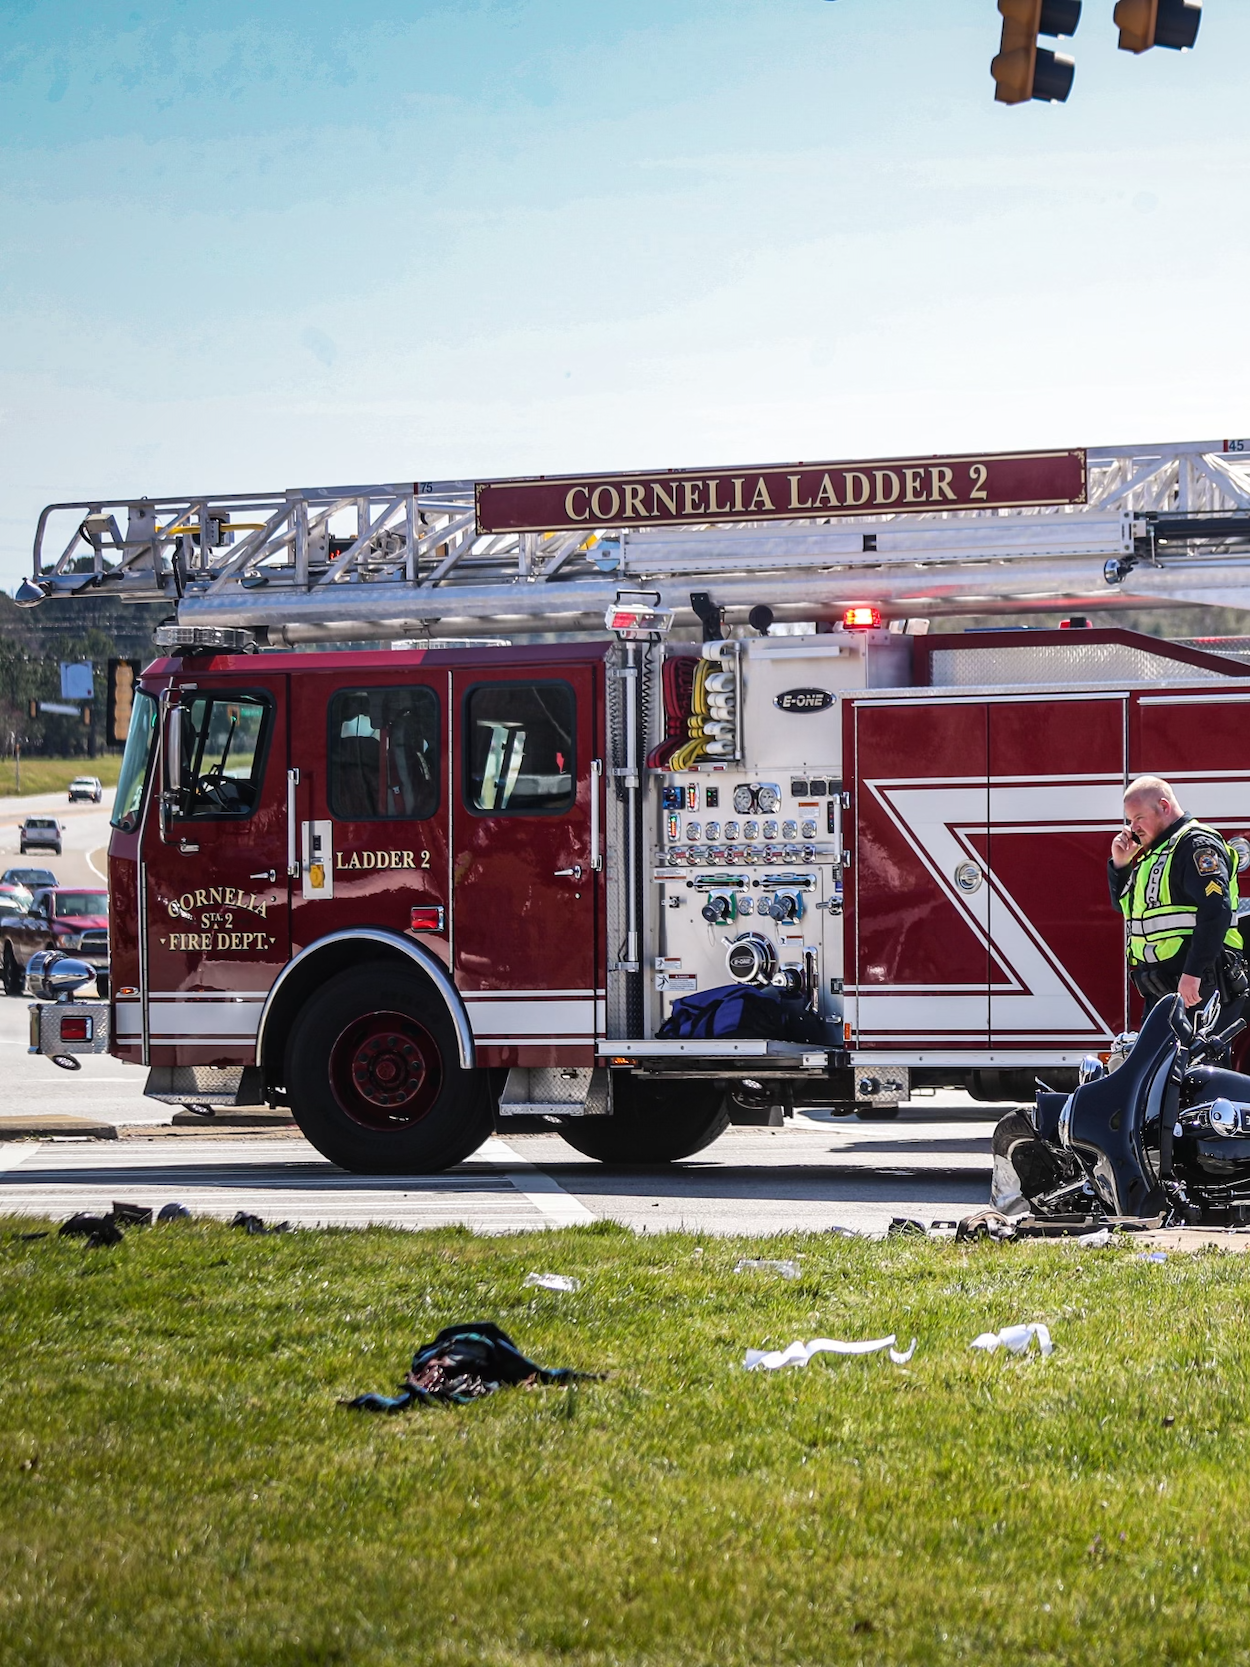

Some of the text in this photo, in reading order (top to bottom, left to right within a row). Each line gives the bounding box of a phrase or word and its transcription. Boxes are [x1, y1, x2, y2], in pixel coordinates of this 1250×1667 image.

[1229, 440, 1245, 451] 45
[420, 482, 433, 494] 75
[564, 463, 989, 521] CORNELIA LADDER 2
[782, 694, 824, 708] E-ONE
[336, 850, 431, 870] LADDER 2
[167, 887, 267, 919] CORNELIA
[225, 912, 233, 928] 2
[168, 932, 269, 951] FIRE DEPT.
